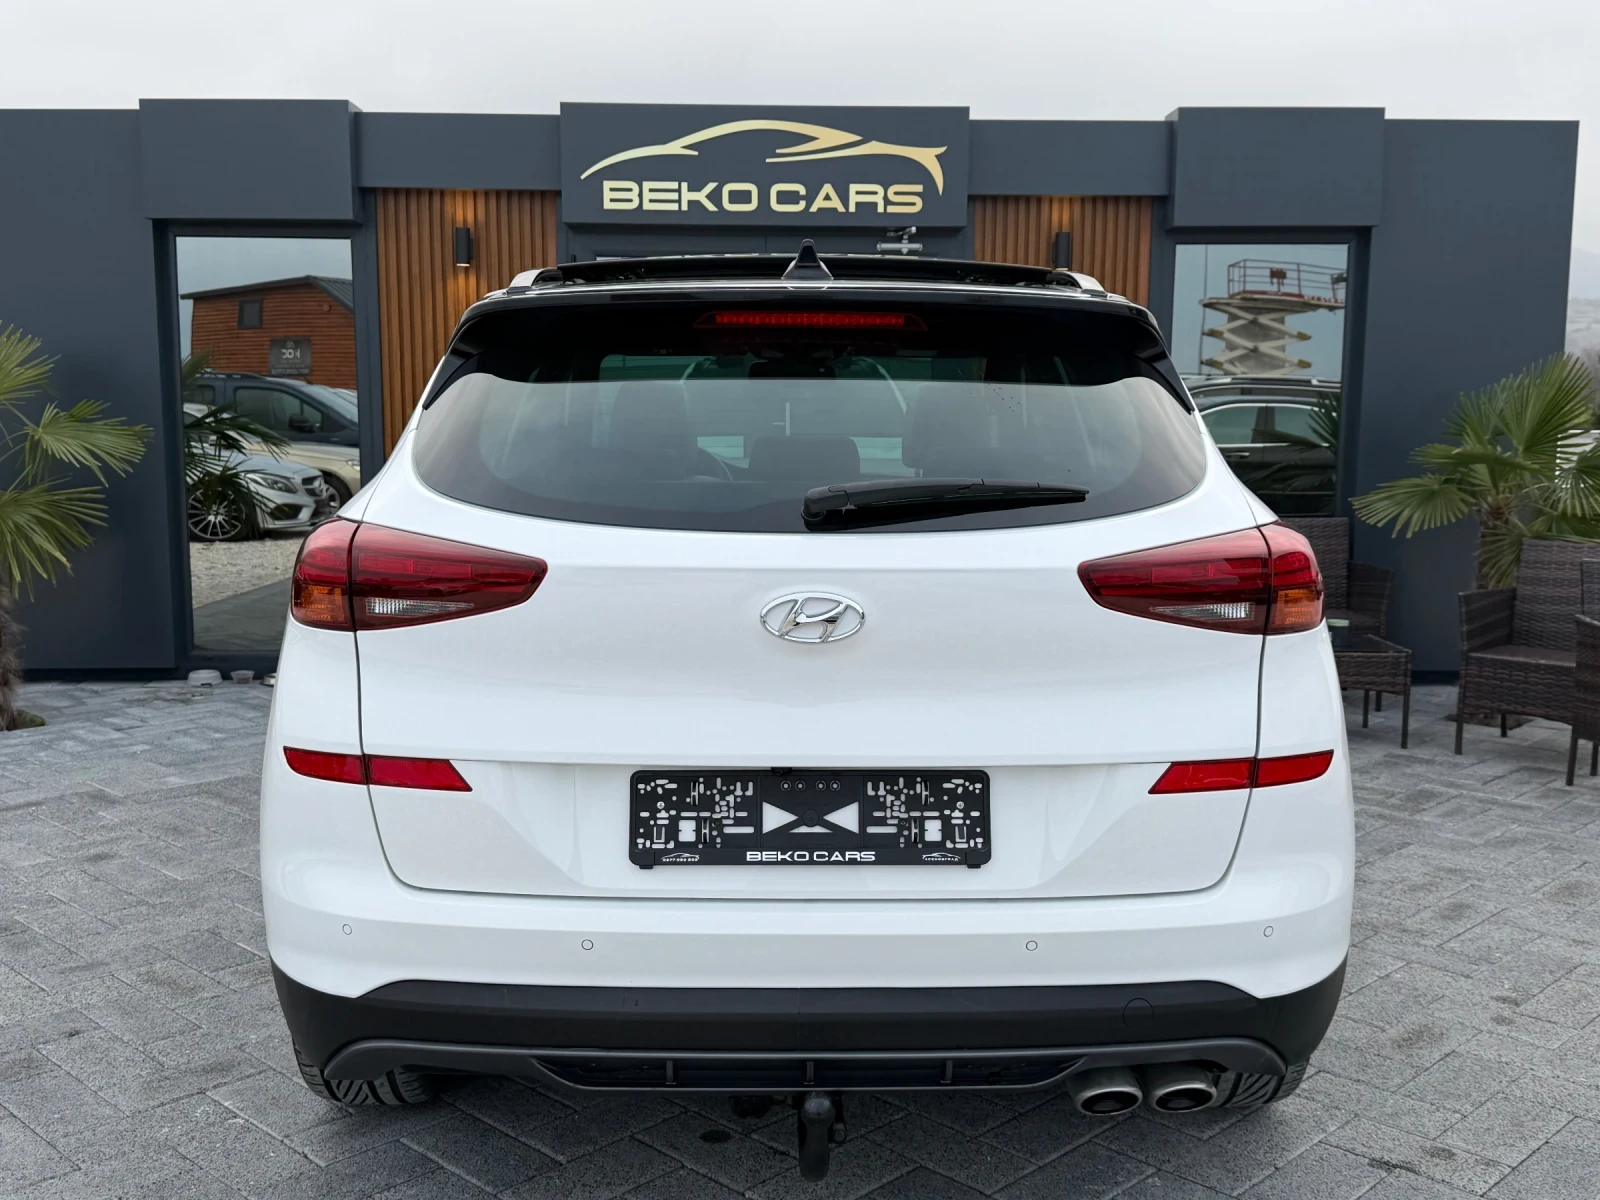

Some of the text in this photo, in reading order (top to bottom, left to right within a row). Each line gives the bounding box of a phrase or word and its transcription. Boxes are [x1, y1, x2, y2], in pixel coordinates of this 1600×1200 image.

[602, 180, 924, 214] BEKO CARS
[746, 851, 876, 862] BEKO CARS
